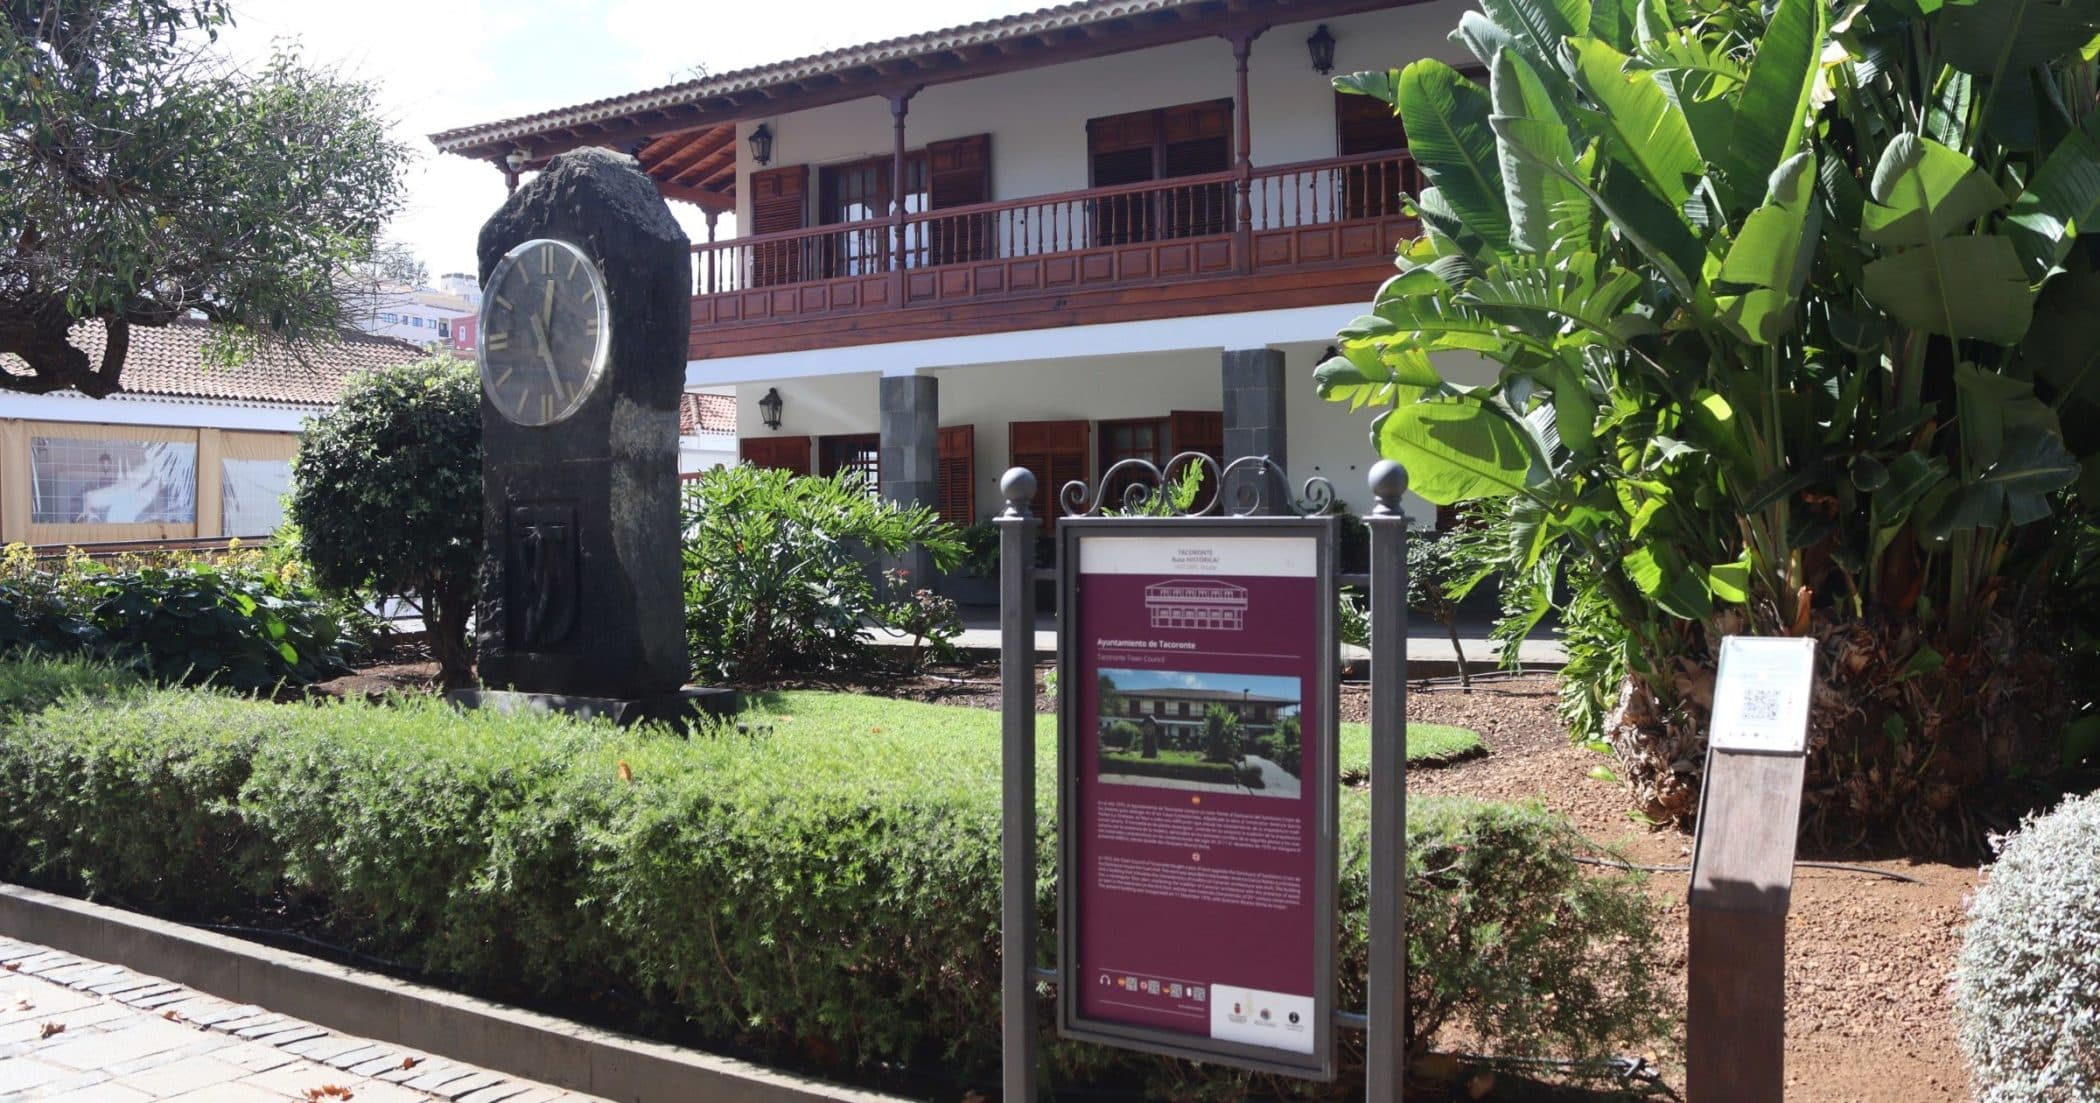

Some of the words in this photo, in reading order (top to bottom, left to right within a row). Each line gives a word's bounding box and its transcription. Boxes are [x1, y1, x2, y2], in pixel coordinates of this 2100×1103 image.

[1097, 638, 1147, 648] Ayuntamiento
[1148, 640, 1158, 648] de
[1159, 640, 1196, 649] Tacoronte
[1144, 654, 1165, 663] Council
